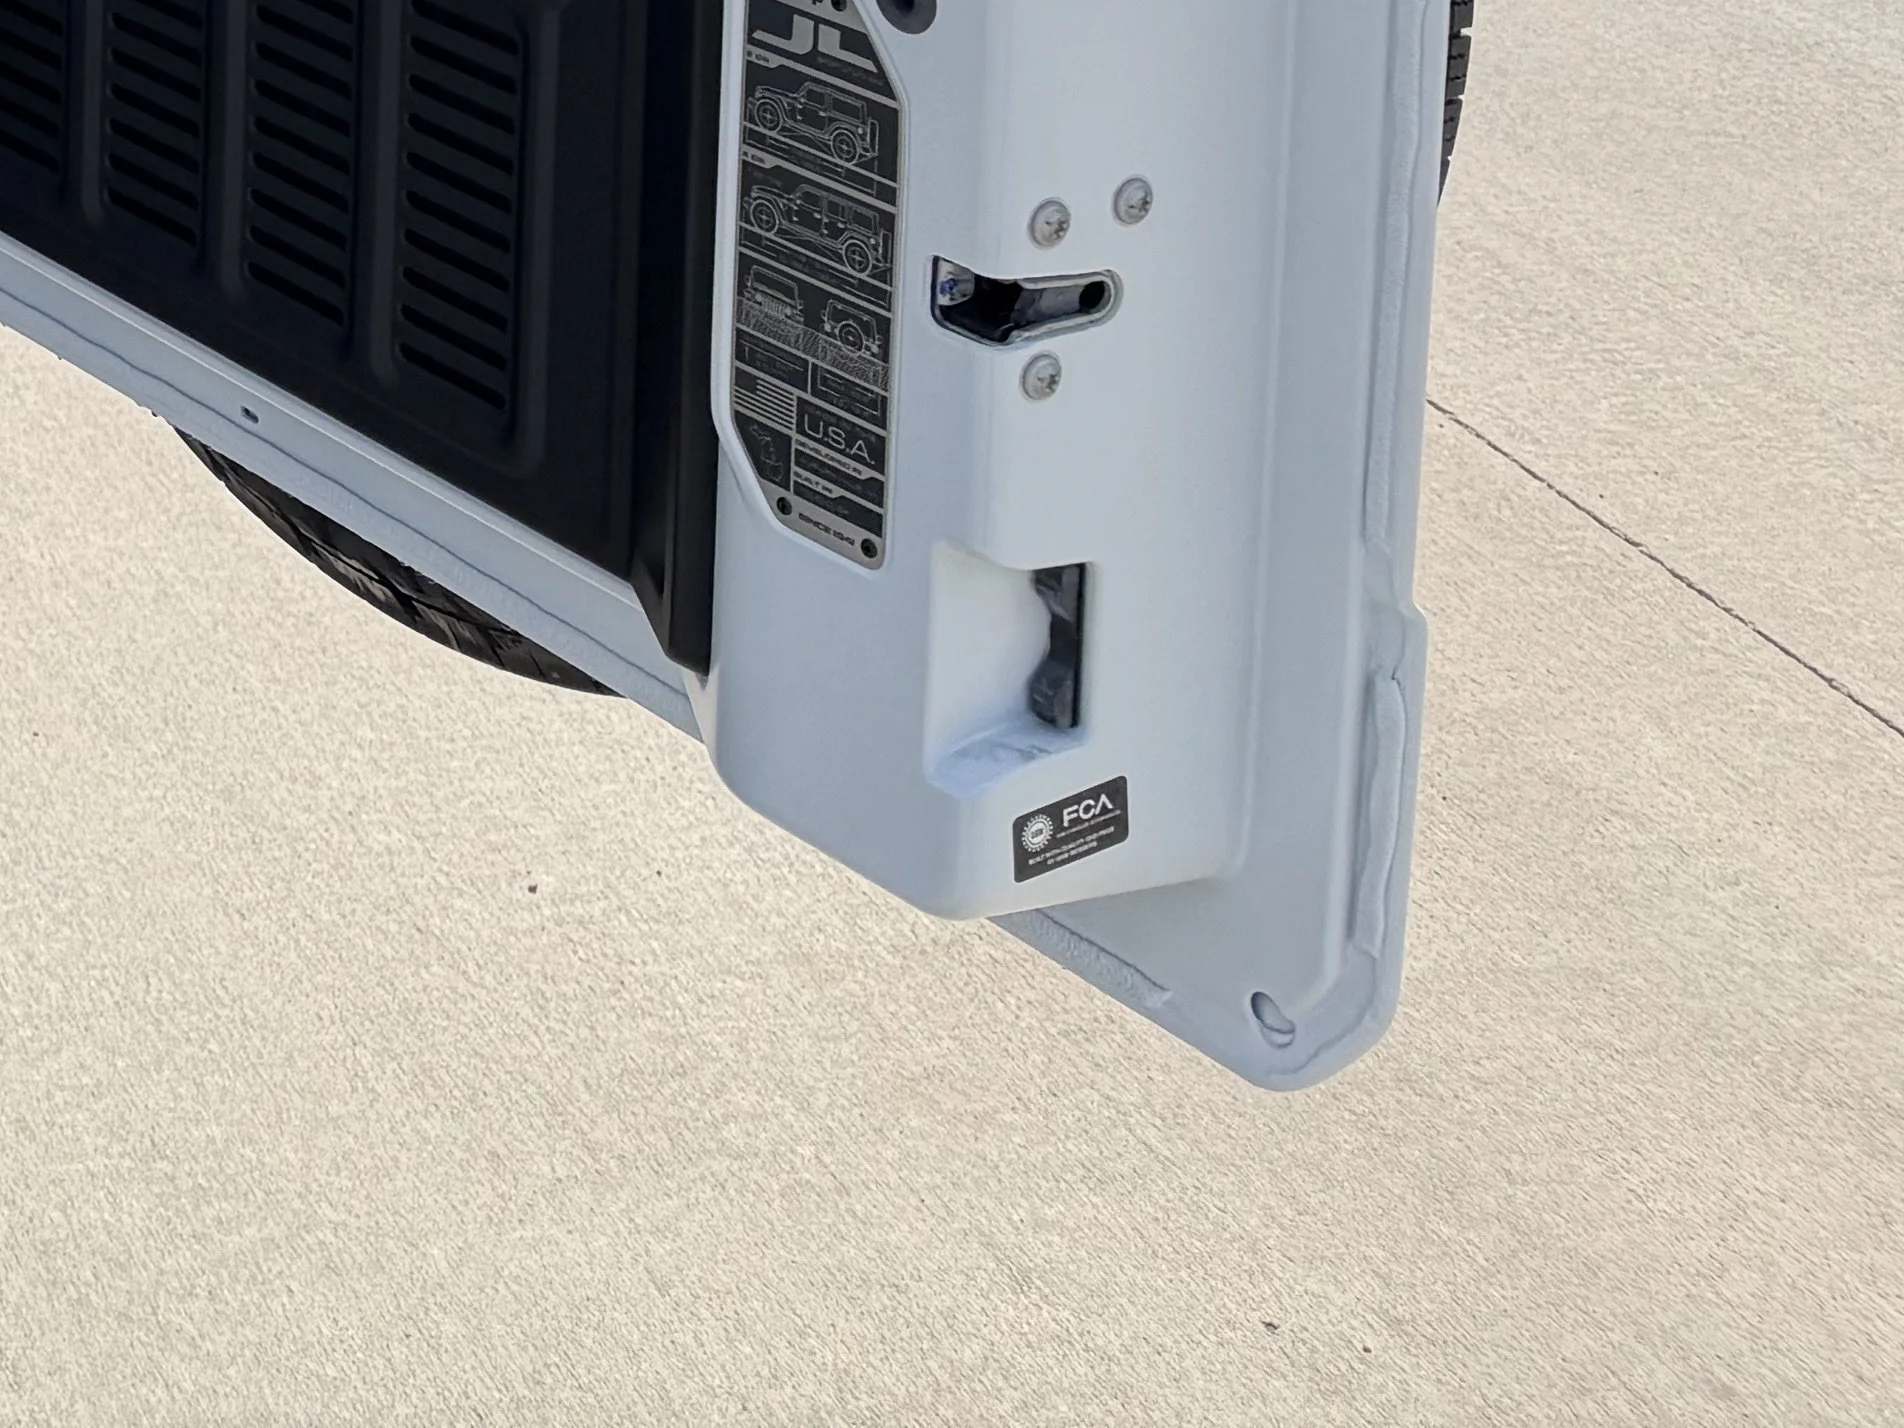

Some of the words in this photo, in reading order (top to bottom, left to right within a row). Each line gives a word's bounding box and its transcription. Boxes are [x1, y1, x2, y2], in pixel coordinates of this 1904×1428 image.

[751, 13, 879, 73] JL
[804, 413, 876, 465] U.S.A.
[1062, 793, 1114, 827] FCA
